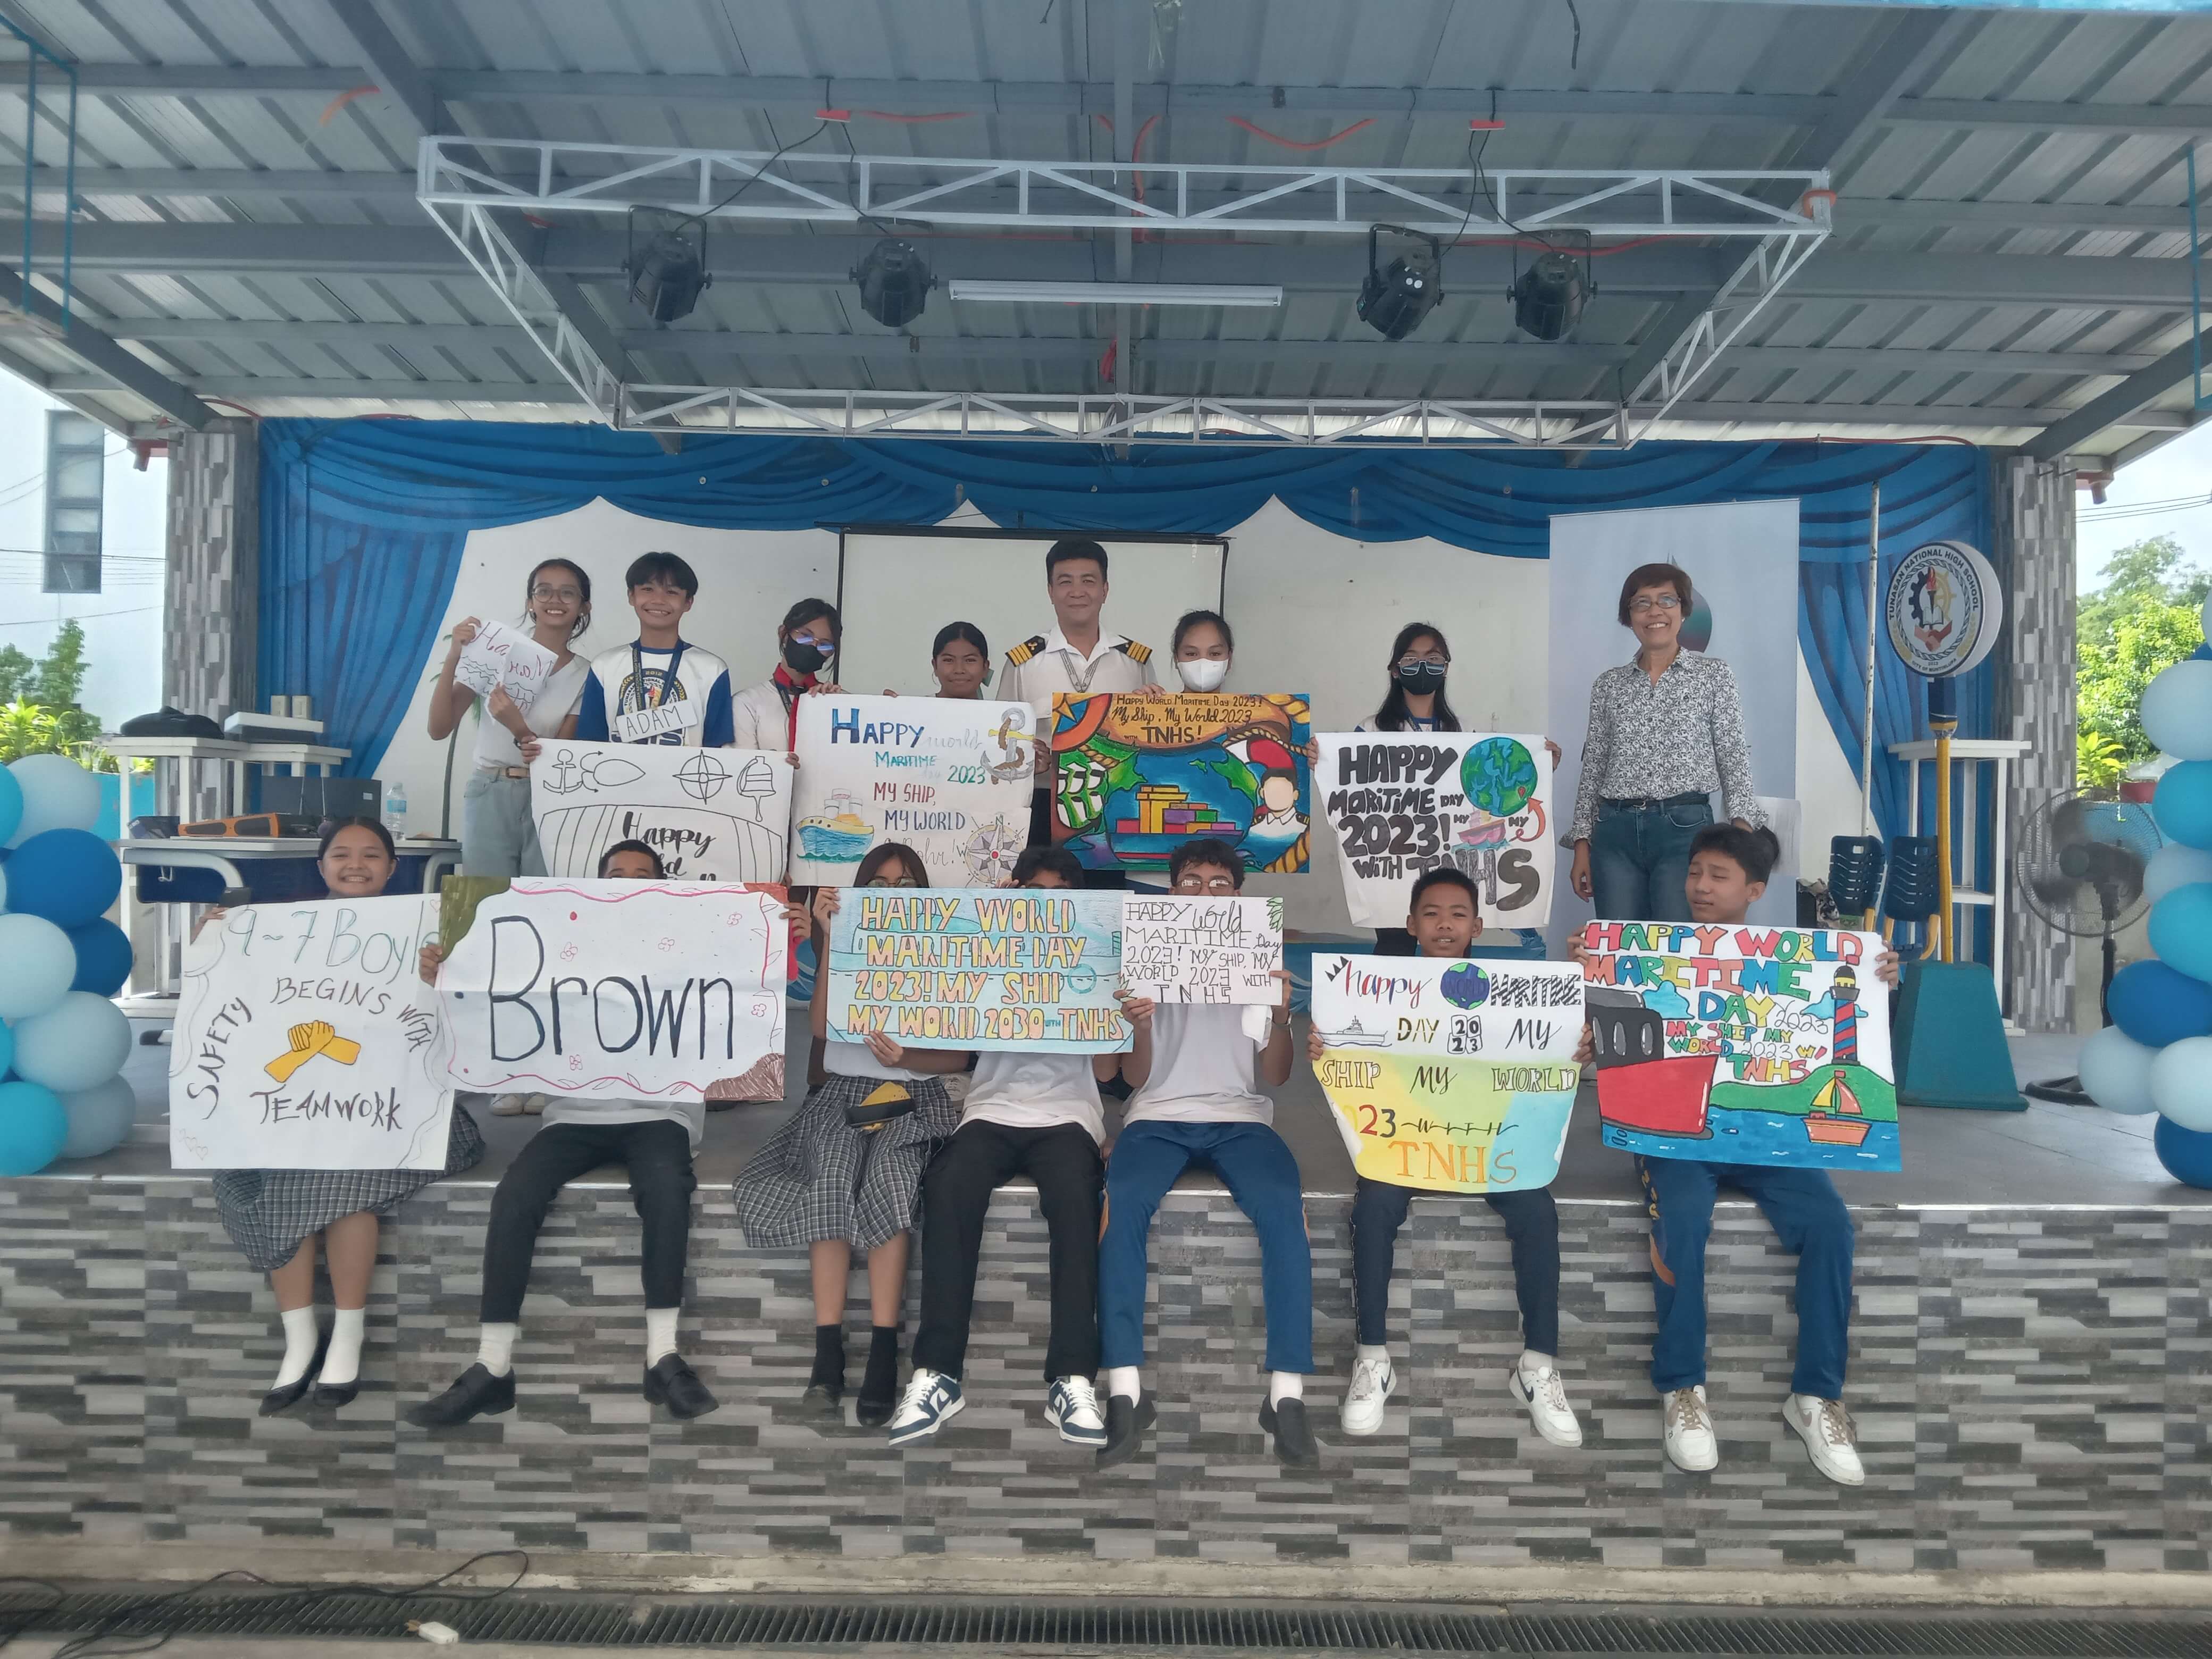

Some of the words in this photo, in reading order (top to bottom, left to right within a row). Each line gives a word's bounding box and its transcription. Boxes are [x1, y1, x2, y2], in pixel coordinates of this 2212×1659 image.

[1889, 572, 1905, 620] TUNASAN
[1905, 549, 1943, 572] NATIONAL
[1945, 551, 1964, 568] HIGH
[1963, 568, 1979, 611] SCHOOL
[626, 706, 683, 737] ADAM
[831, 708, 925, 748] HAPPY
[1164, 708, 1180, 727] My
[1184, 708, 1218, 723] World
[1219, 709, 1252, 724] 2023
[1141, 725, 1202, 744] TNHS!
[947, 765, 986, 784] 2023
[1338, 744, 1459, 785] HAPPY
[873, 782, 896, 802] MY
[903, 783, 936, 806] SHIP,
[1440, 794, 1464, 808] DAY
[623, 811, 716, 858] Happy
[884, 810, 909, 837] MY
[914, 811, 966, 831] WORLD
[1453, 814, 1470, 824] MY
[1508, 816, 1529, 828] MY
[1338, 813, 1451, 858] 2023!
[861, 896, 960, 932] HAPPY
[975, 898, 1076, 934] WORLD
[1125, 902, 1193, 921] HAPPY
[867, 935, 1032, 968] MARITIME
[1033, 936, 1087, 968] DAY
[1126, 926, 1252, 949] MARITIME
[1584, 921, 1728, 956] HAPPY
[1734, 928, 1863, 962] WORLD
[1126, 945, 1182, 964] 2023!
[488, 915, 734, 1061] Brown
[854, 970, 932, 1002] 2023!
[936, 971, 989, 1004] MY
[1001, 971, 1064, 1004] SHIP
[1124, 965, 1179, 982] WORLD
[1189, 967, 1230, 987] 2023
[1242, 974, 1271, 987] WITH
[1583, 954, 1813, 1002] MARITIME
[848, 1004, 892, 1036] MY
[1058, 1008, 1124, 1041] TNHS
[1698, 991, 1777, 1028] DAY
[1774, 1010, 1829, 1035] 2023
[1397, 1017, 1439, 1044] DAY
[1665, 1021, 1703, 1037] MY
[1707, 1023, 1758, 1042] SHIP
[1763, 1027, 1794, 1043] MY
[187, 996, 252, 1120] SAFETY
[270, 976, 391, 1015] BEGINS
[396, 1004, 434, 1053] WITH
[1668, 1037, 1734, 1058] WORLD
[1740, 1041, 1793, 1060] 2023
[1321, 1060, 1381, 1089] SHIP
[1491, 1067, 1577, 1093] WORLD
[1725, 1053, 1811, 1084] TNHS
[1388, 1140, 1517, 1184] TNHS
